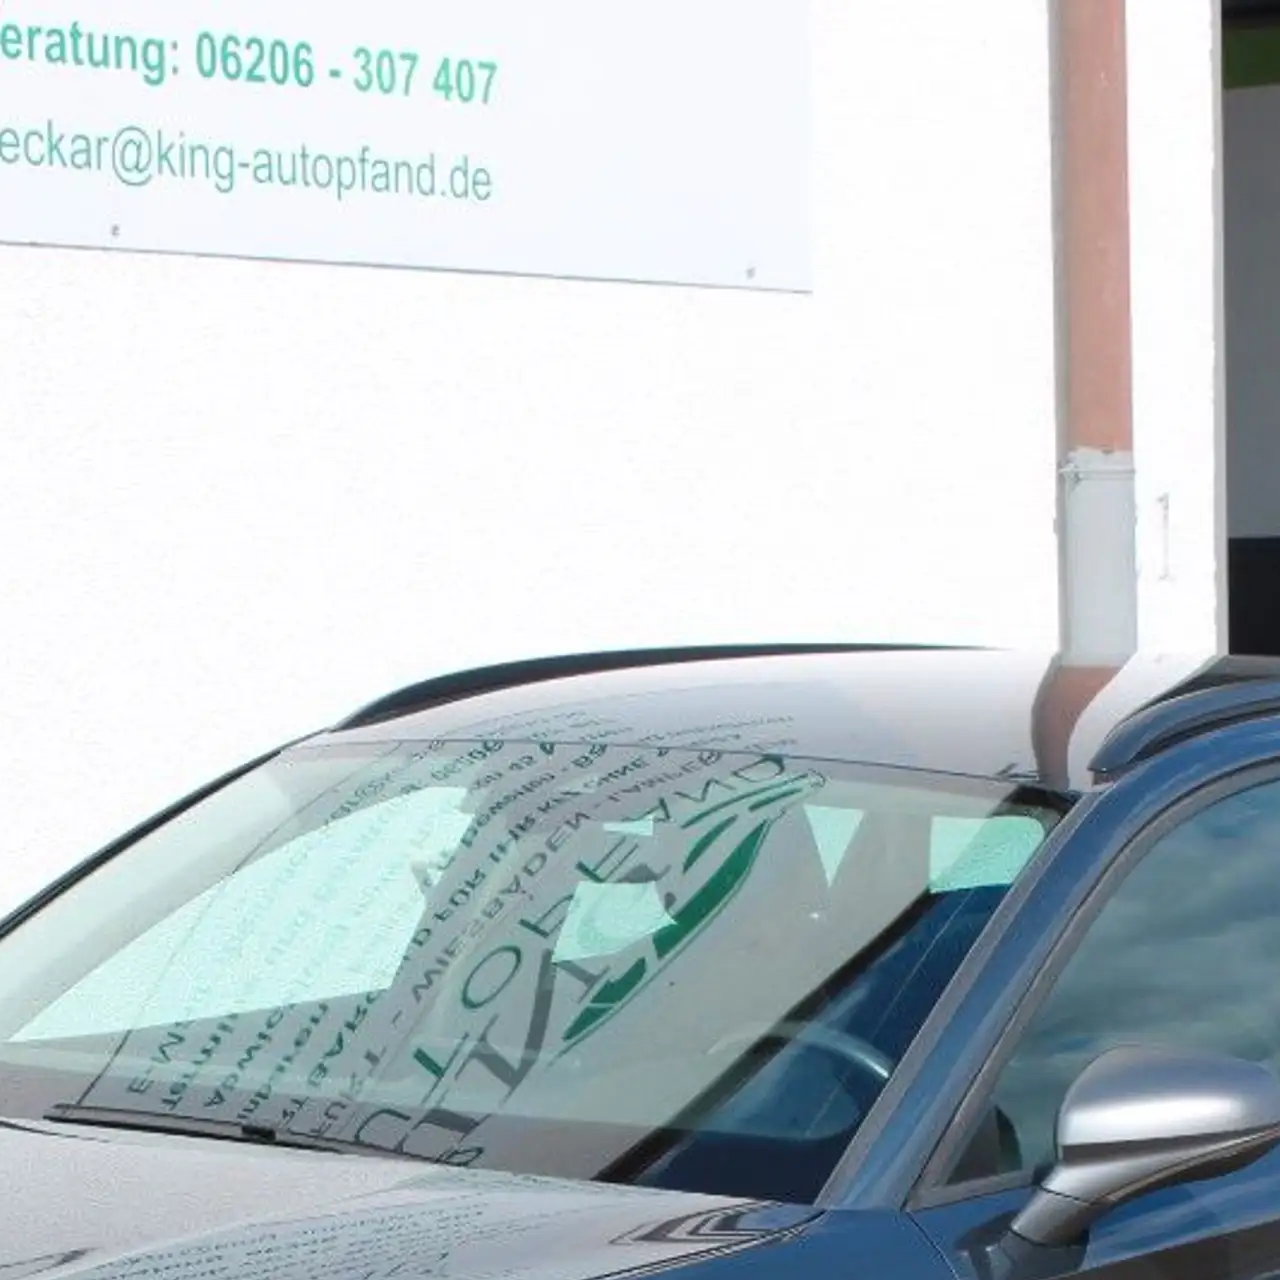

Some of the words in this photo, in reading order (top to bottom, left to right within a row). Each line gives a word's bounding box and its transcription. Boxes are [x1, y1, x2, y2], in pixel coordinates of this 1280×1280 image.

[195, 31, 315, 88] 06206
[328, 67, 342, 79] -
[352, 46, 419, 96] 307
[432, 56, 498, 104] 407
